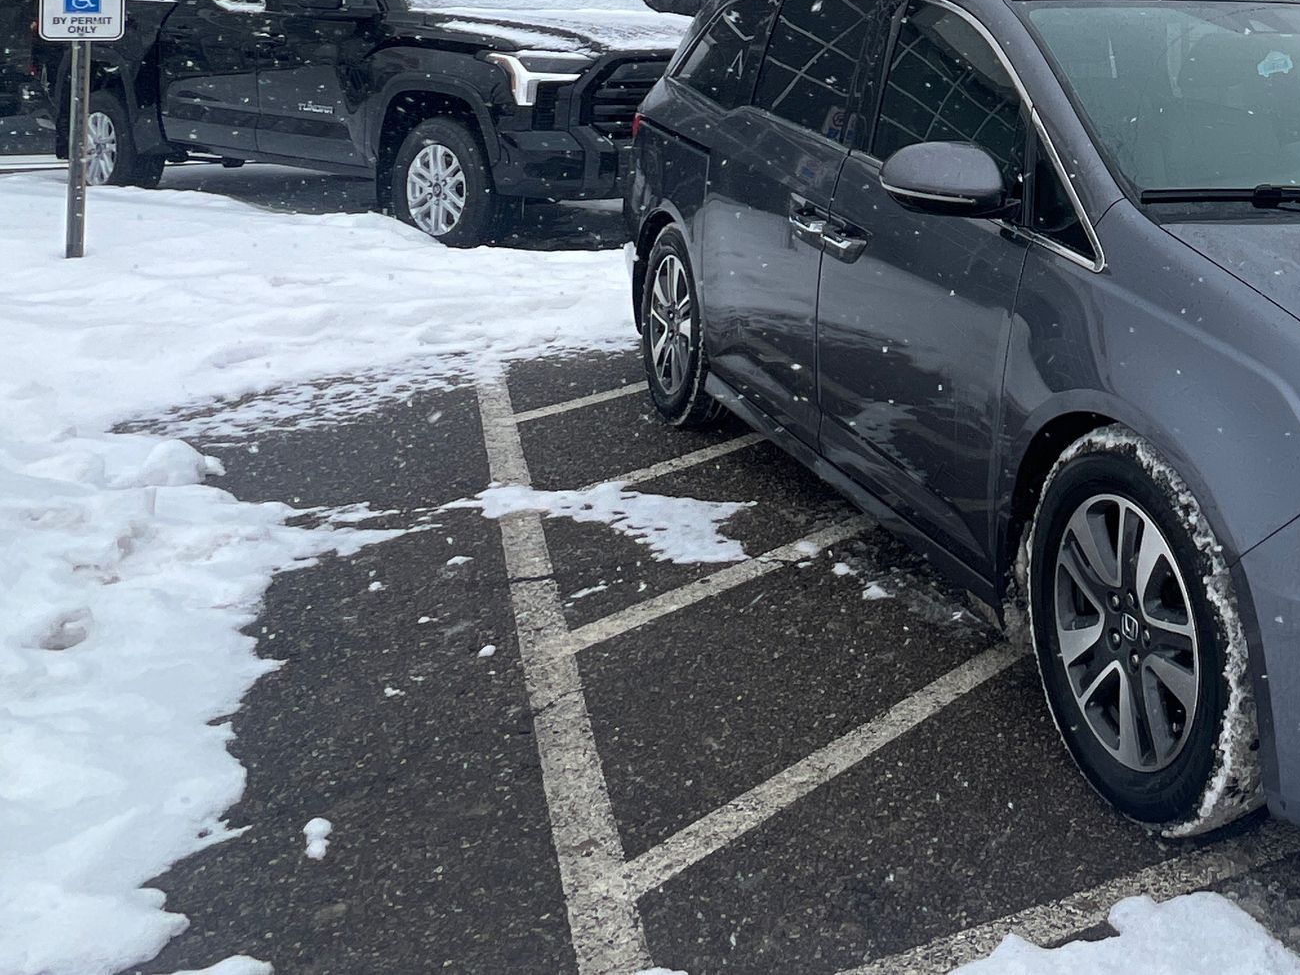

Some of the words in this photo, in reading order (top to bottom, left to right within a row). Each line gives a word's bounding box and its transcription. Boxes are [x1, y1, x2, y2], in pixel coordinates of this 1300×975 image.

[53, 17, 67, 25] BY
[71, 17, 113, 25] PERMIT
[68, 26, 97, 34] ONLY
